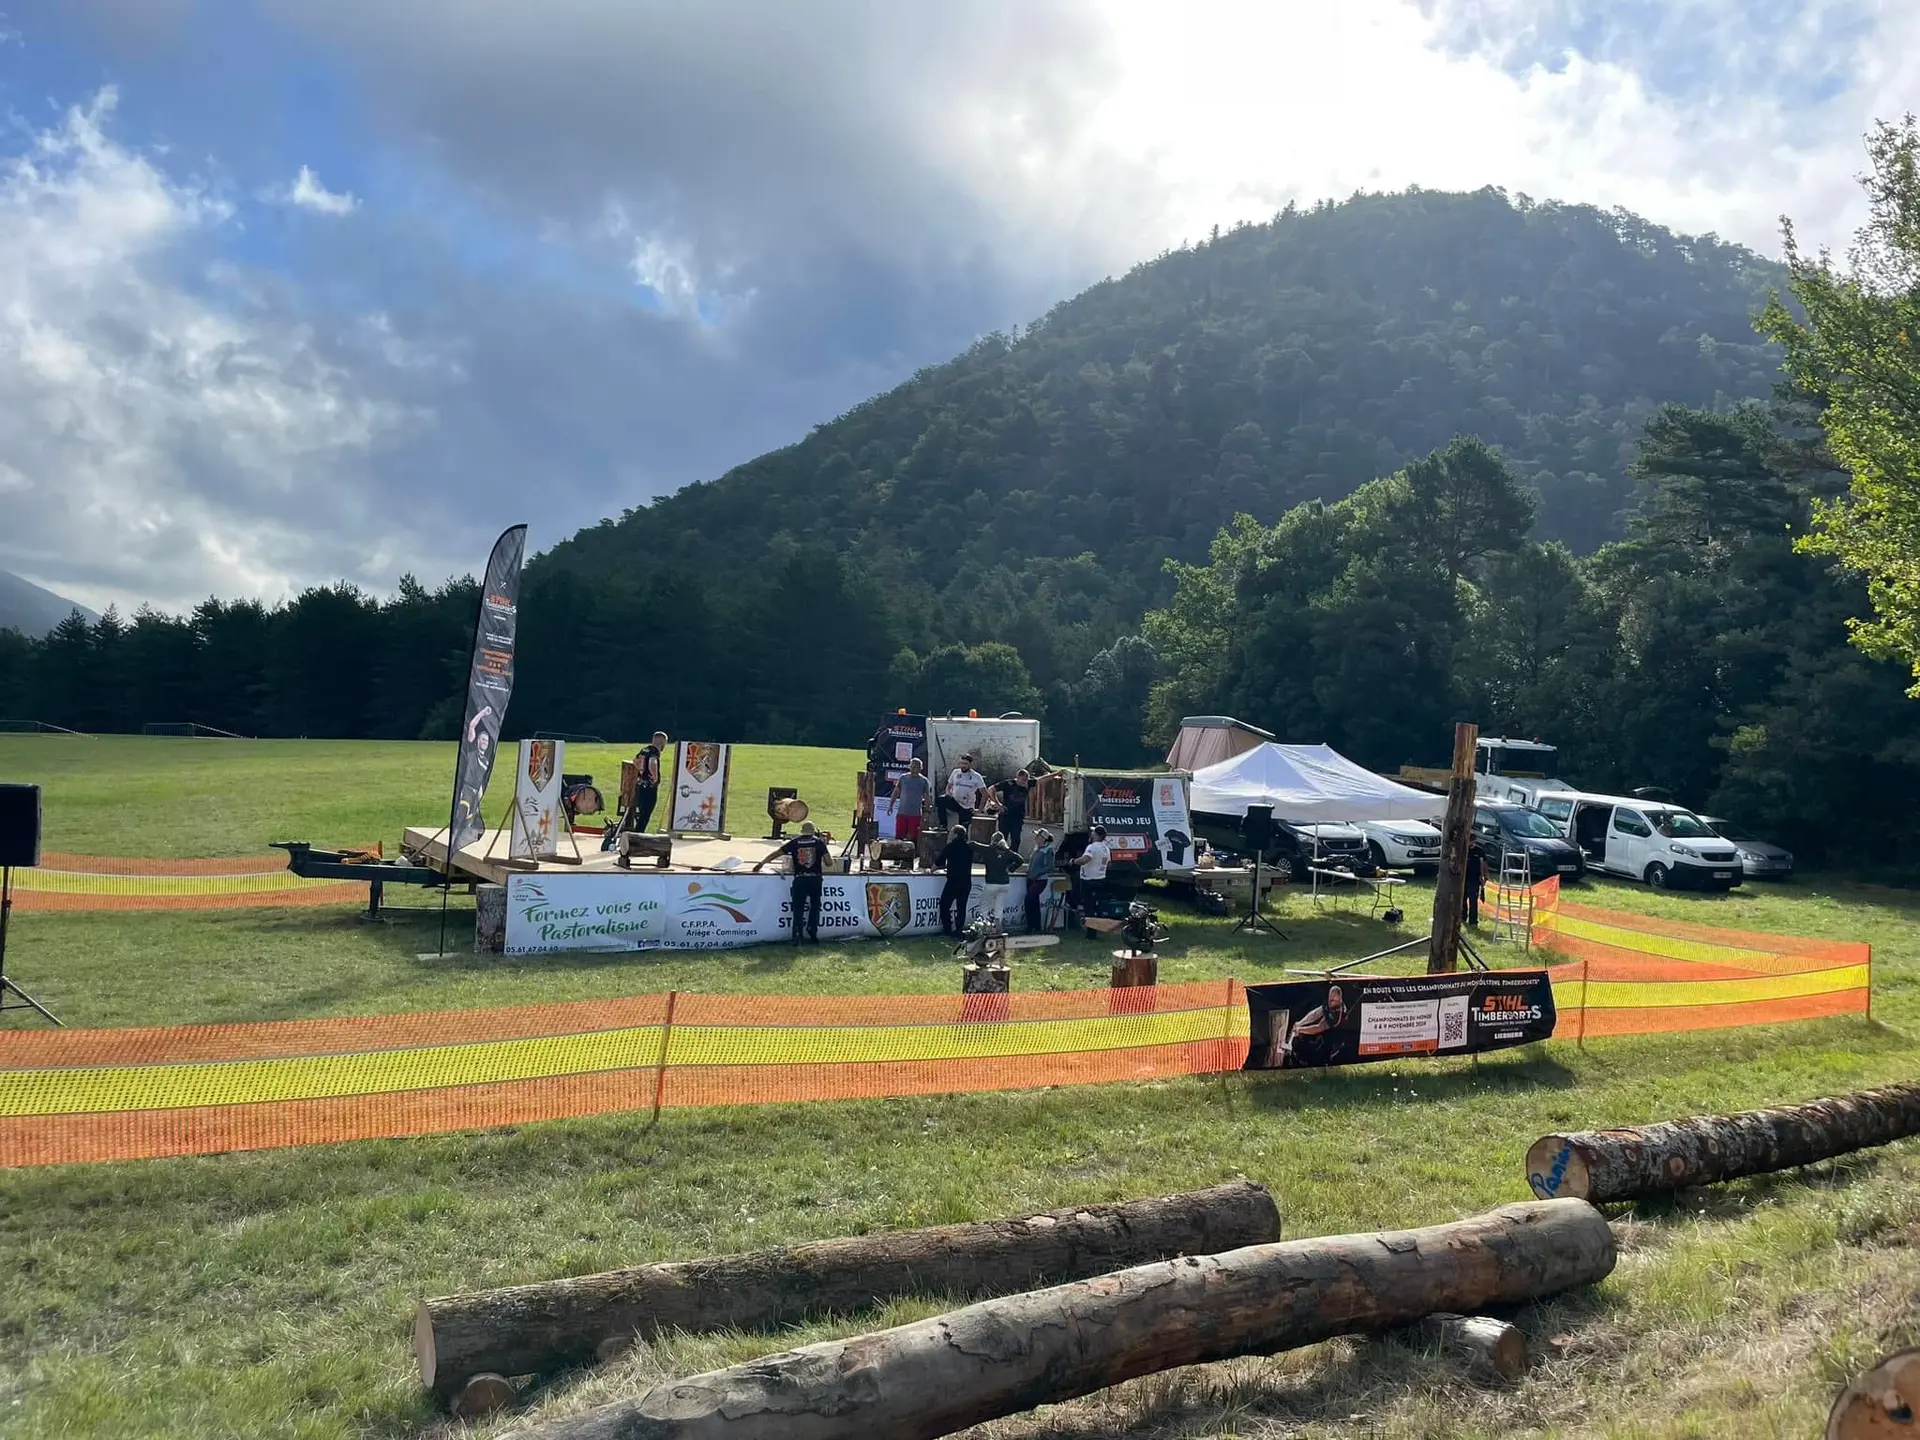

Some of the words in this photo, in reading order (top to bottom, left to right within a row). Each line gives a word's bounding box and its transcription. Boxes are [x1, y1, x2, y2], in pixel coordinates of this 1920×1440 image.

[1092, 816, 1104, 824] LE
[1105, 816, 1134, 825] GRAND
[1136, 817, 1151, 825] JEU
[518, 902, 589, 923] Formez
[596, 901, 632, 915] vous
[639, 901, 658, 911] au
[778, 917, 793, 928] ST
[914, 912, 927, 928] DE
[537, 918, 649, 941] Pastoralisme
[716, 928, 758, 936] Comminges
[1417, 981, 1459, 991] CHAMPIONNATS
[1483, 995, 1528, 1011] STIHL
